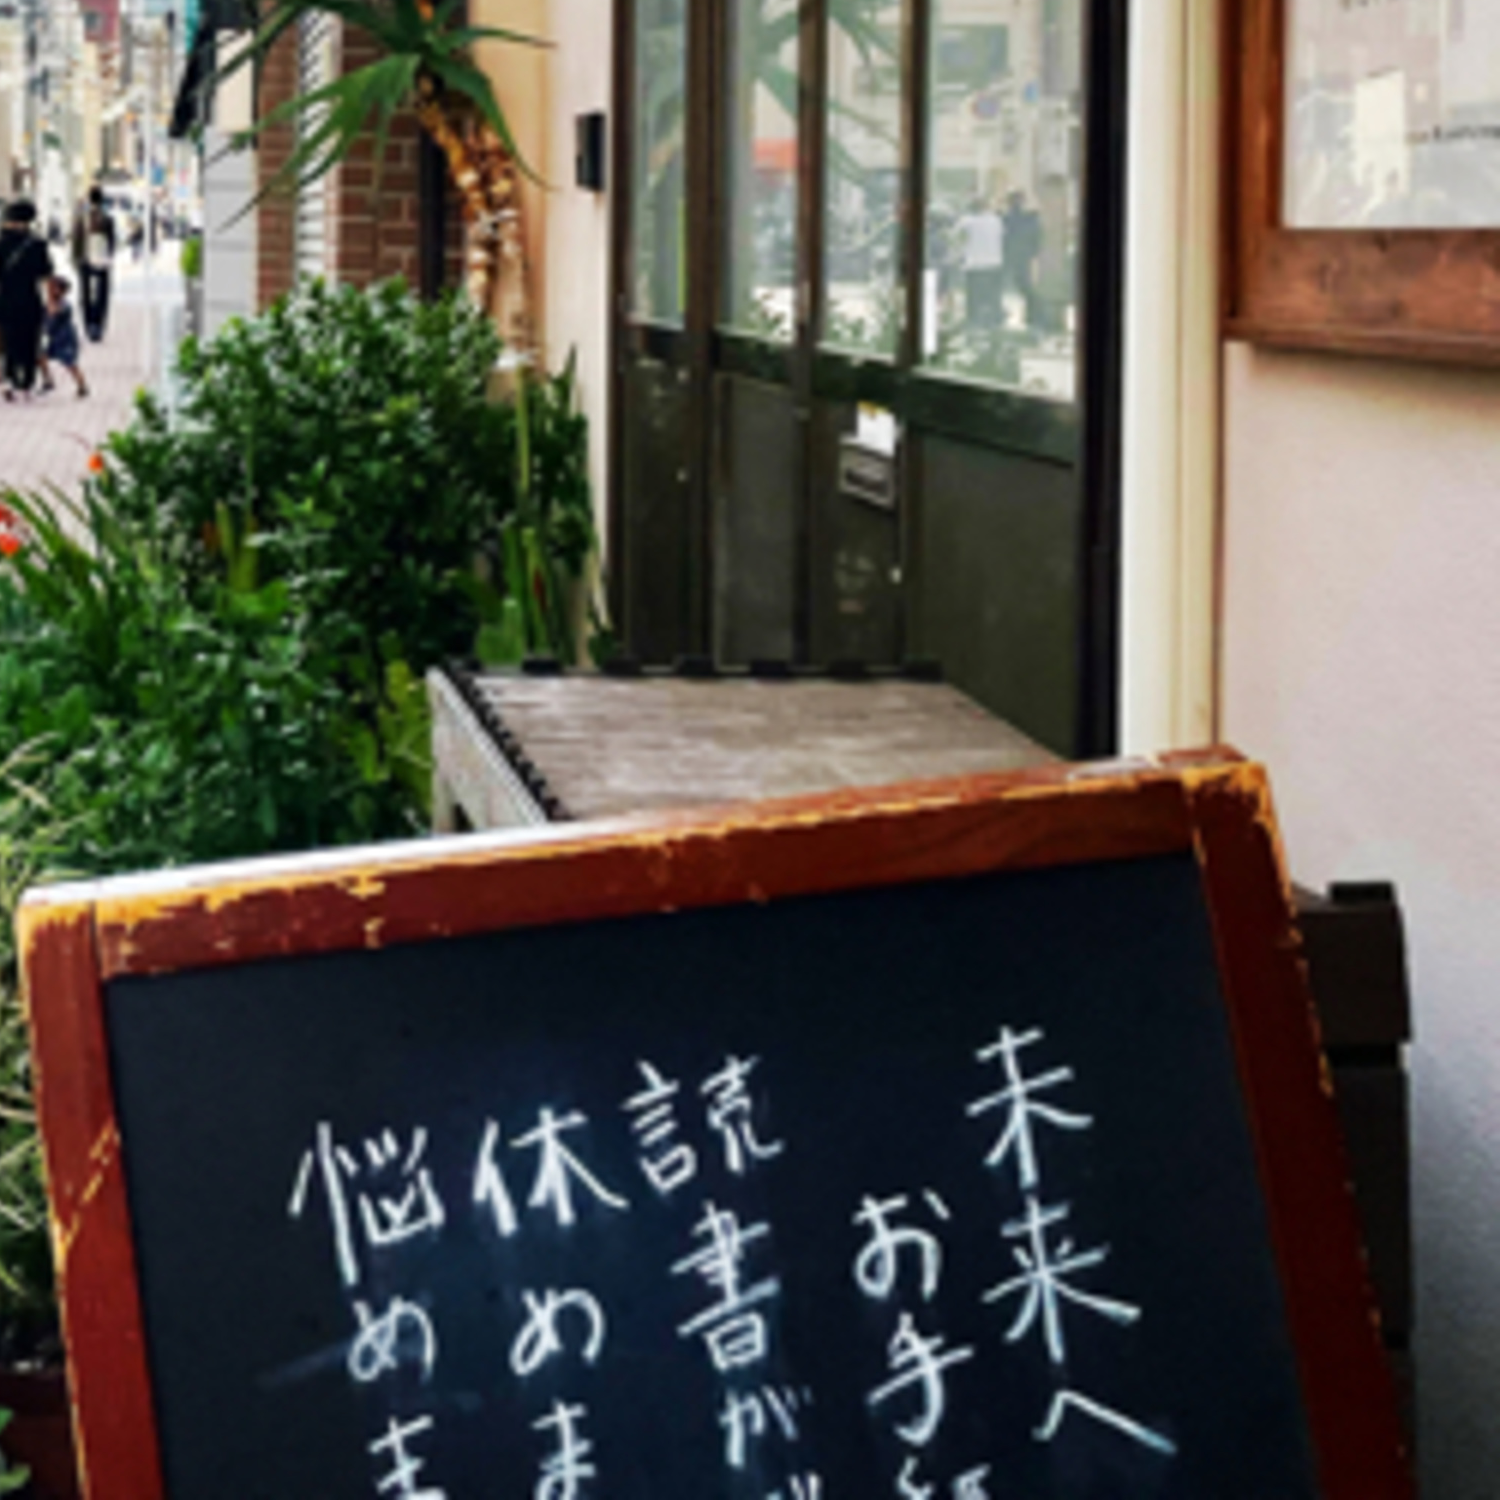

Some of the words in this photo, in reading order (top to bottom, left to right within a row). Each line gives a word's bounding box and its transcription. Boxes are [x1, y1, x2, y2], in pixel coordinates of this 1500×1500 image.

[624, 1056, 821, 1500] 読書が
[852, 1189, 990, 1500] お手
[966, 1025, 1177, 1453] 未来へ
